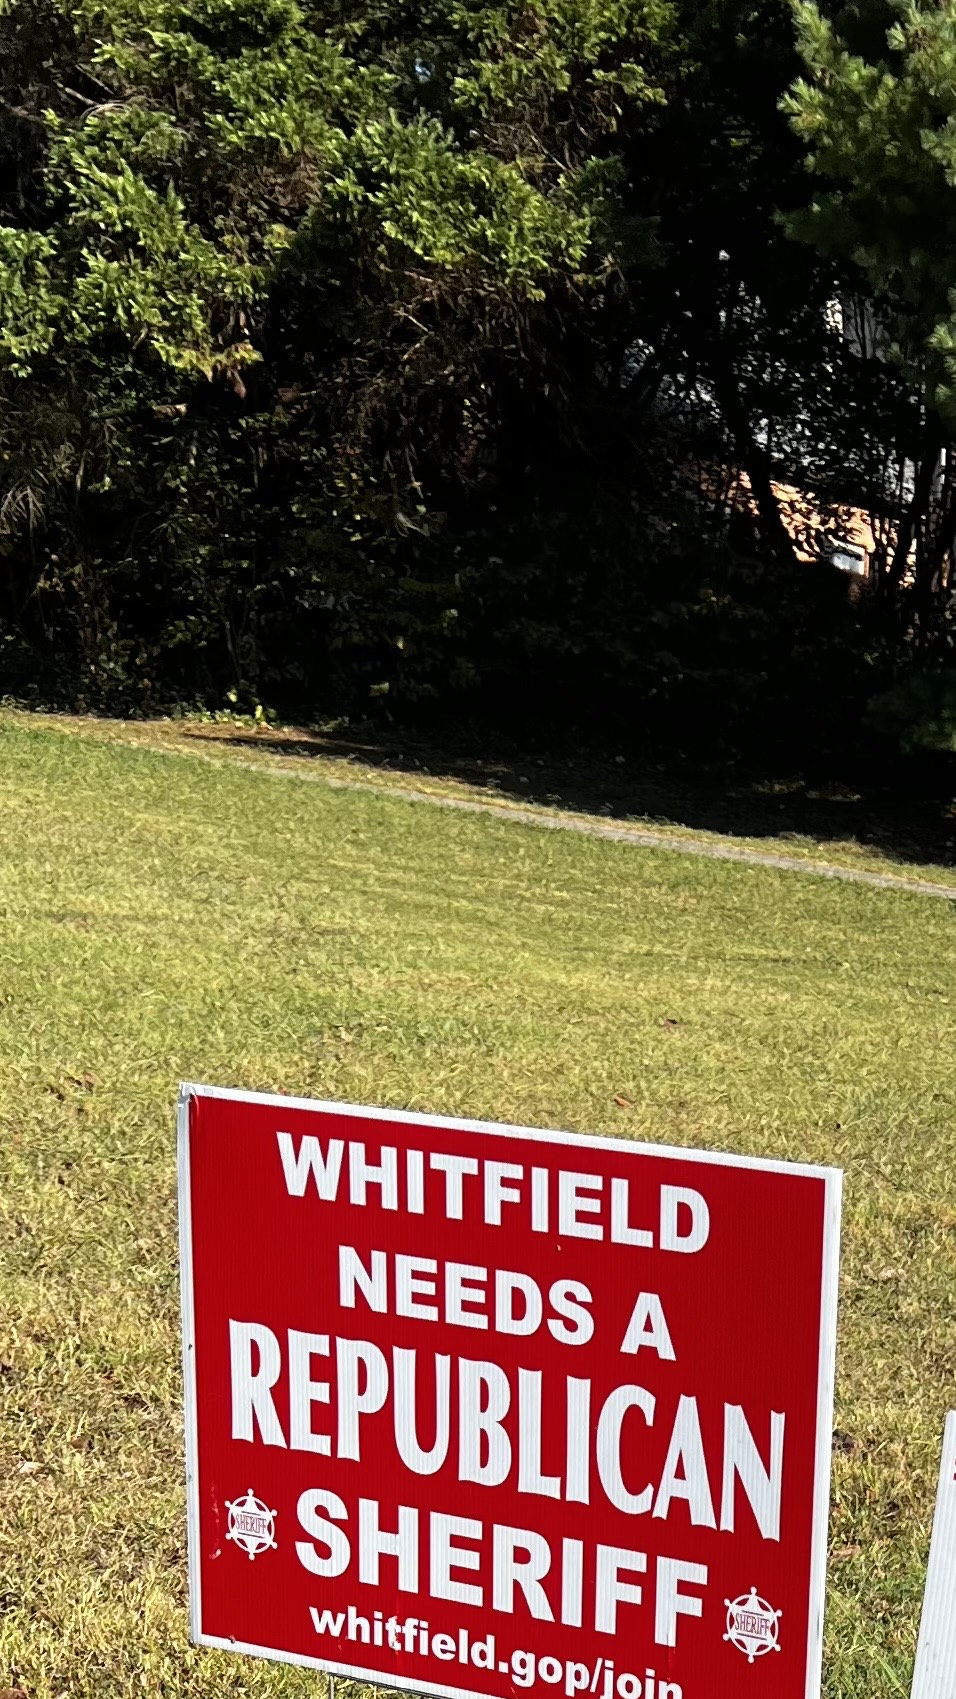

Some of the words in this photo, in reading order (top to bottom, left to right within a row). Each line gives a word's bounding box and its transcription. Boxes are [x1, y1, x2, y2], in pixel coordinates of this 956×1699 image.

[276, 1131, 710, 1254] WHITFIELD
[338, 1245, 595, 1346] NEEDS
[620, 1291, 676, 1361] A
[228, 1319, 785, 1542] REPUBLICAN
[294, 1488, 708, 1647] SHERIFF
[735, 1613, 770, 1636] SHERIFF
